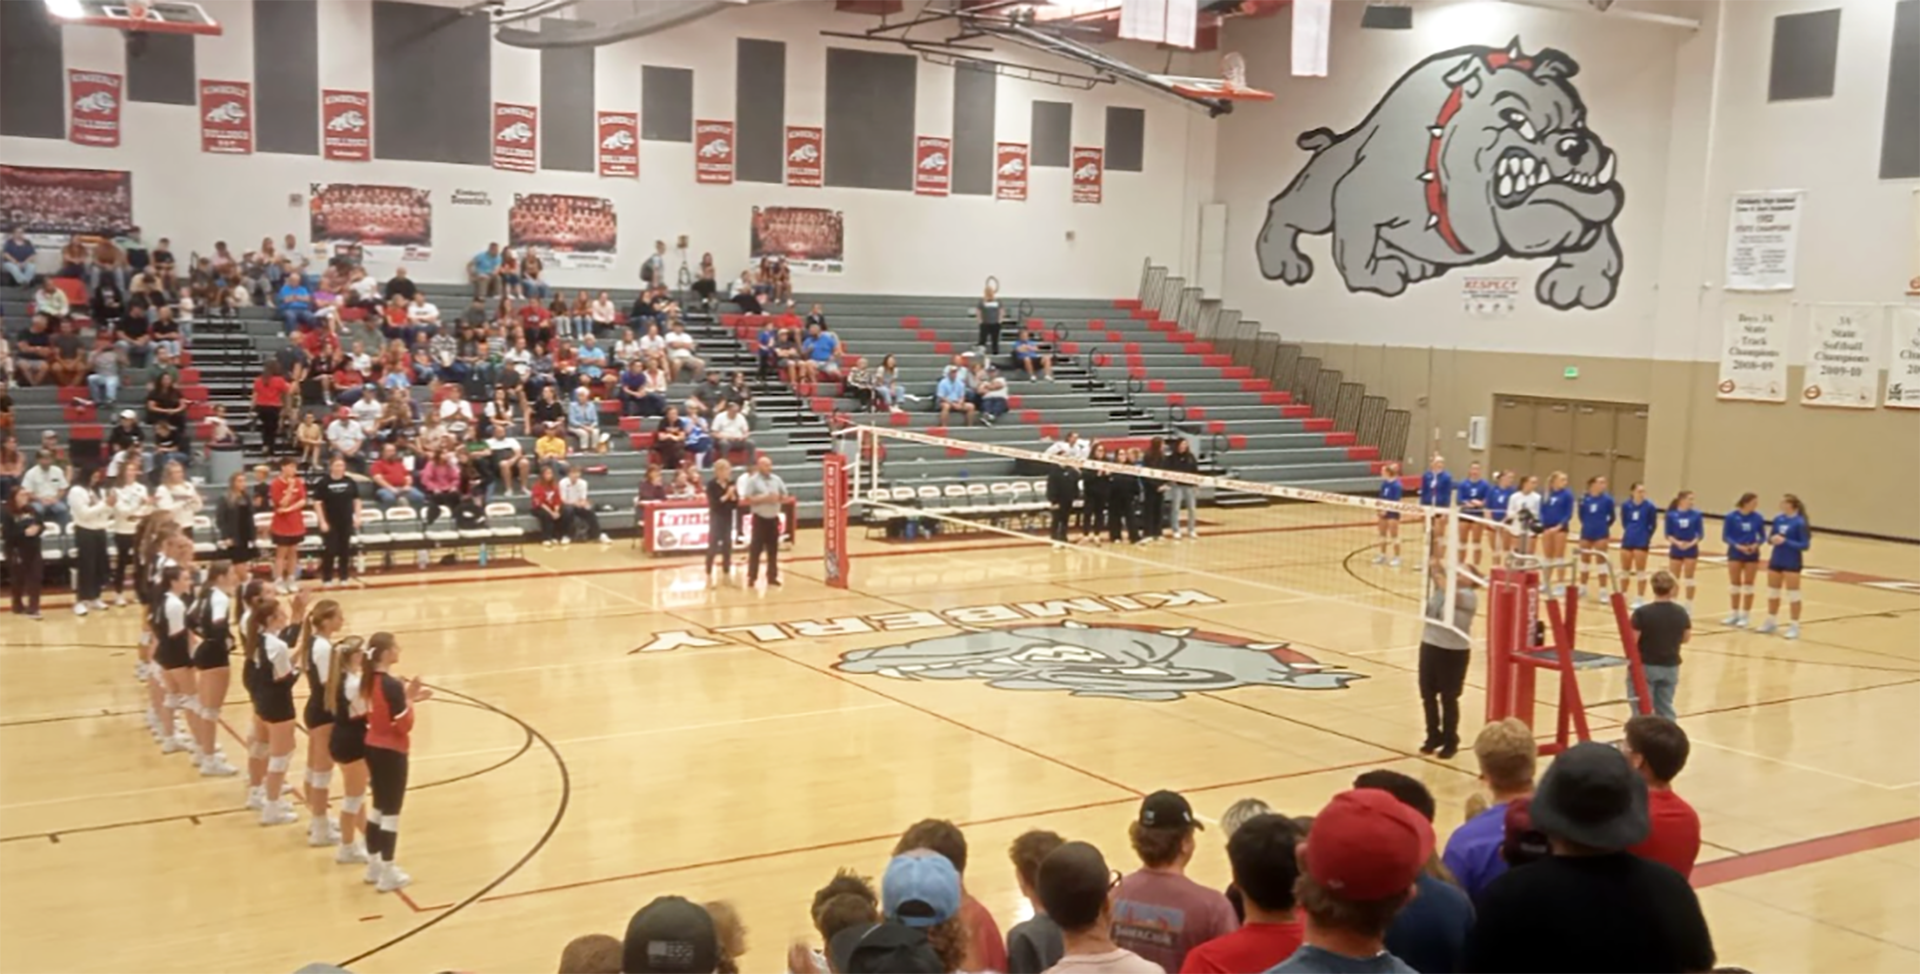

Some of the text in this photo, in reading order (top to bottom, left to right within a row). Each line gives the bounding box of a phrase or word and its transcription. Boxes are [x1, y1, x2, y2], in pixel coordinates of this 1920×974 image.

[1744, 325, 1767, 333] State
[1831, 328, 1856, 338] State
[1741, 336, 1767, 346] Track
[1822, 341, 1863, 351] Softball
[1729, 346, 1779, 358] Champions
[1814, 351, 1870, 363] Champions
[627, 589, 1226, 655] KIMBERLY
